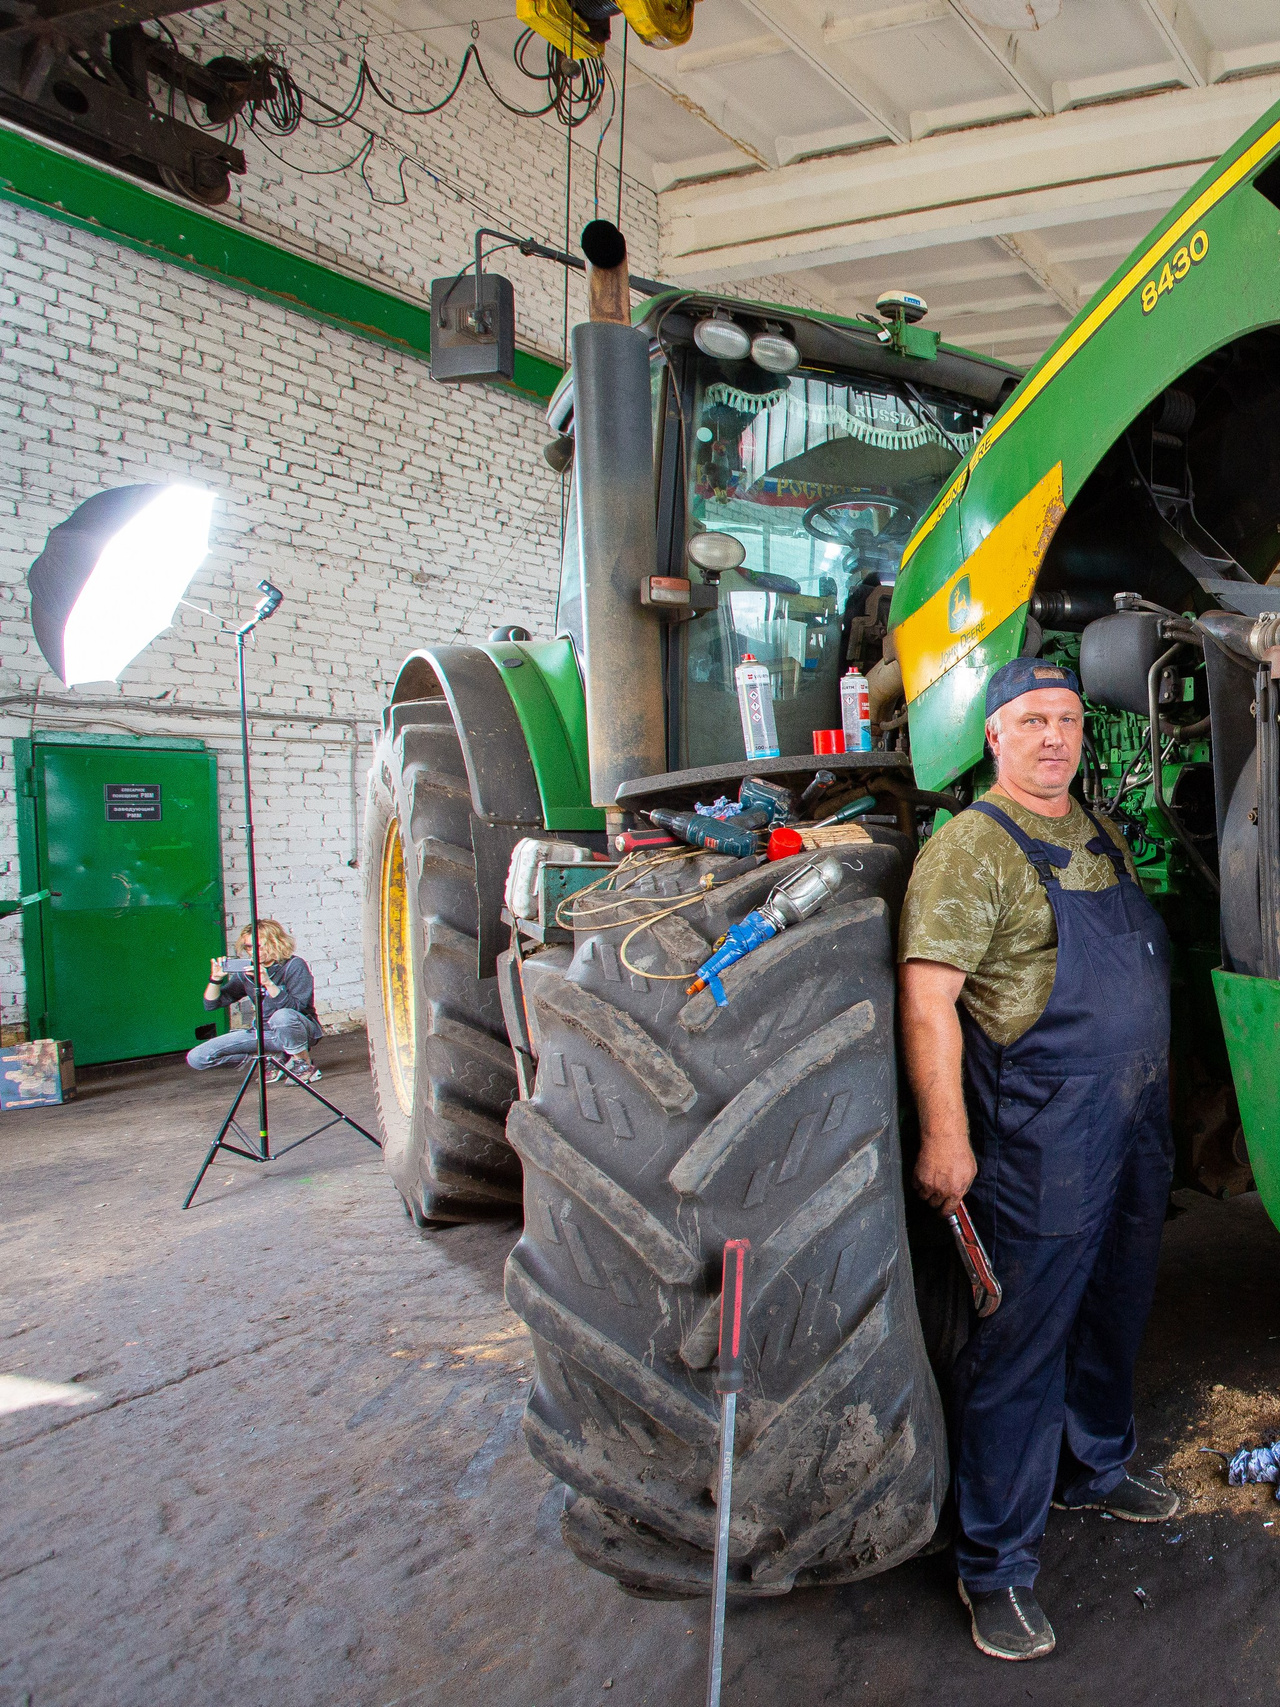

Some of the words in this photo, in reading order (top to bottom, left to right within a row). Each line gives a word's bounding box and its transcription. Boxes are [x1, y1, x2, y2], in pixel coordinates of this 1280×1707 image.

[1141, 229, 1209, 315] 8430
[854, 404, 916, 428] RUSSIA
[960, 619, 987, 647] DEERE
